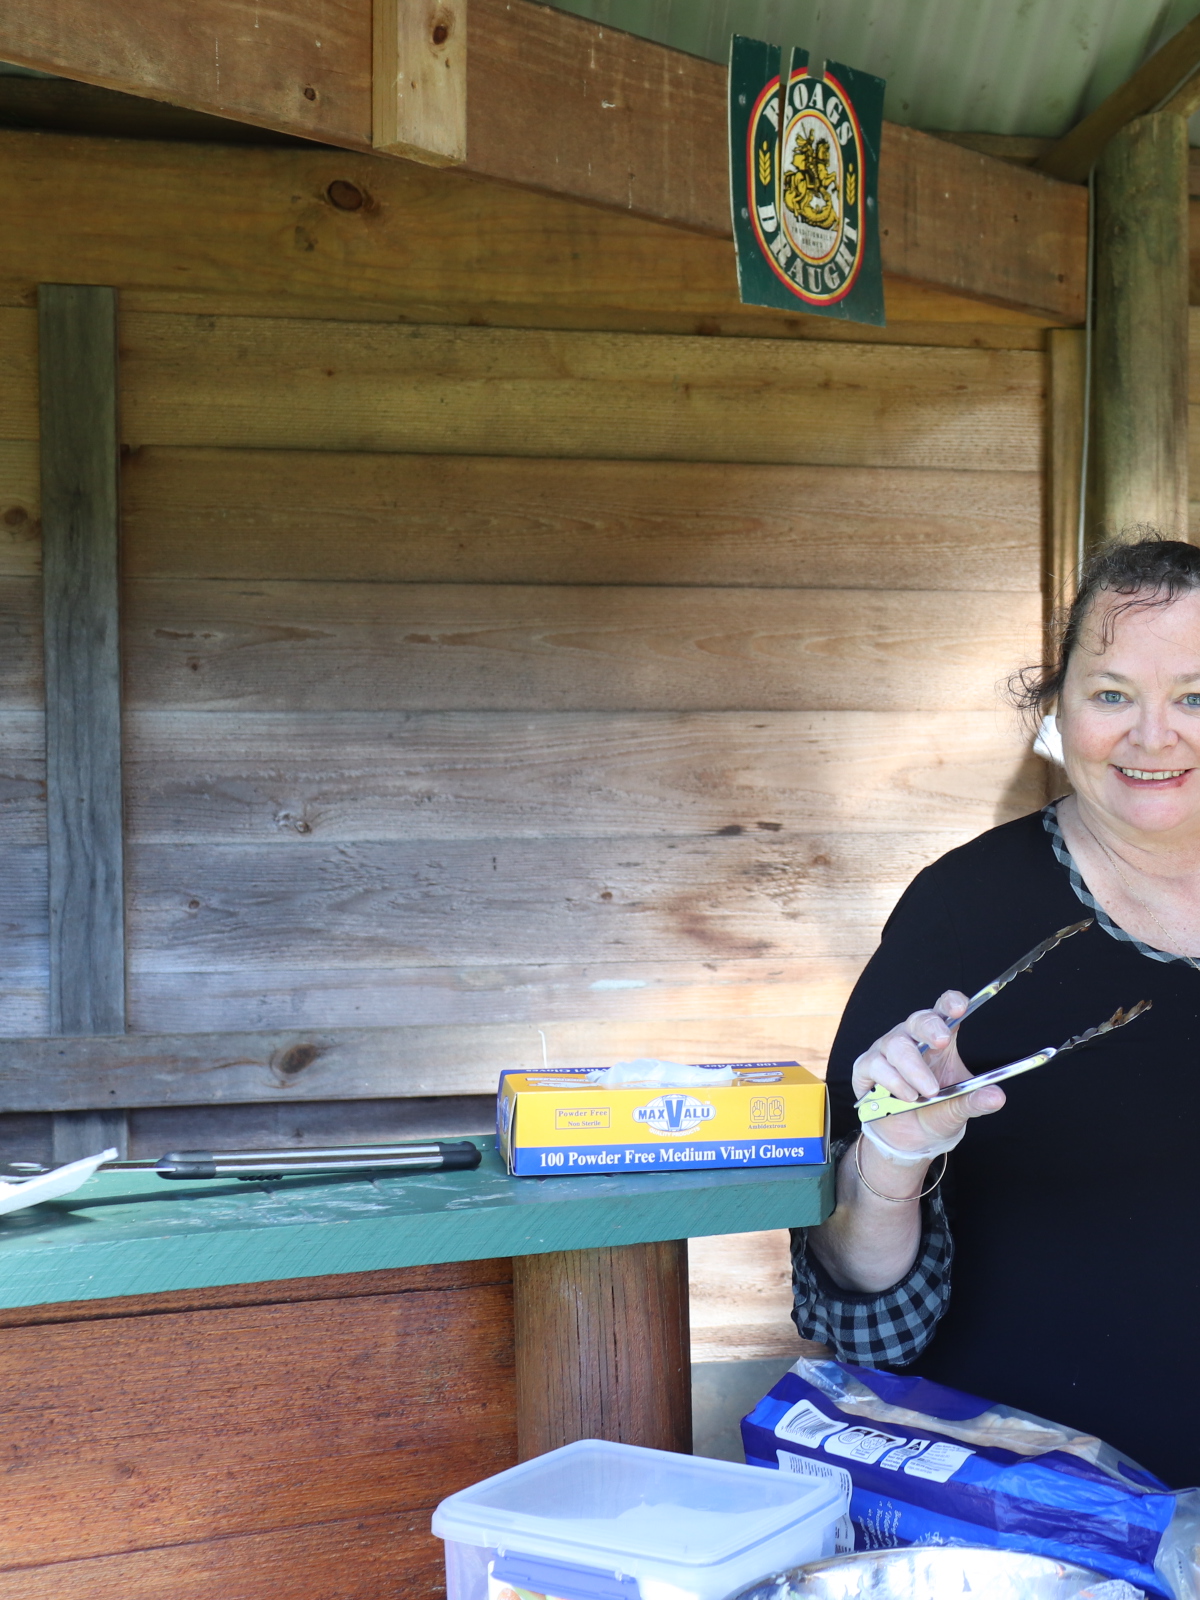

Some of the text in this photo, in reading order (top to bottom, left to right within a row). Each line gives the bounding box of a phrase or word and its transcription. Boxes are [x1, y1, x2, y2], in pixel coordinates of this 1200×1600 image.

[763, 82, 853, 146] BOAGS
[757, 202, 858, 293] DRAUGHT
[649, 1126, 701, 1137] QUALITY PRODUCTS
[540, 1145, 804, 1167] 100 Powder Free Medium Vinyl Gloves
